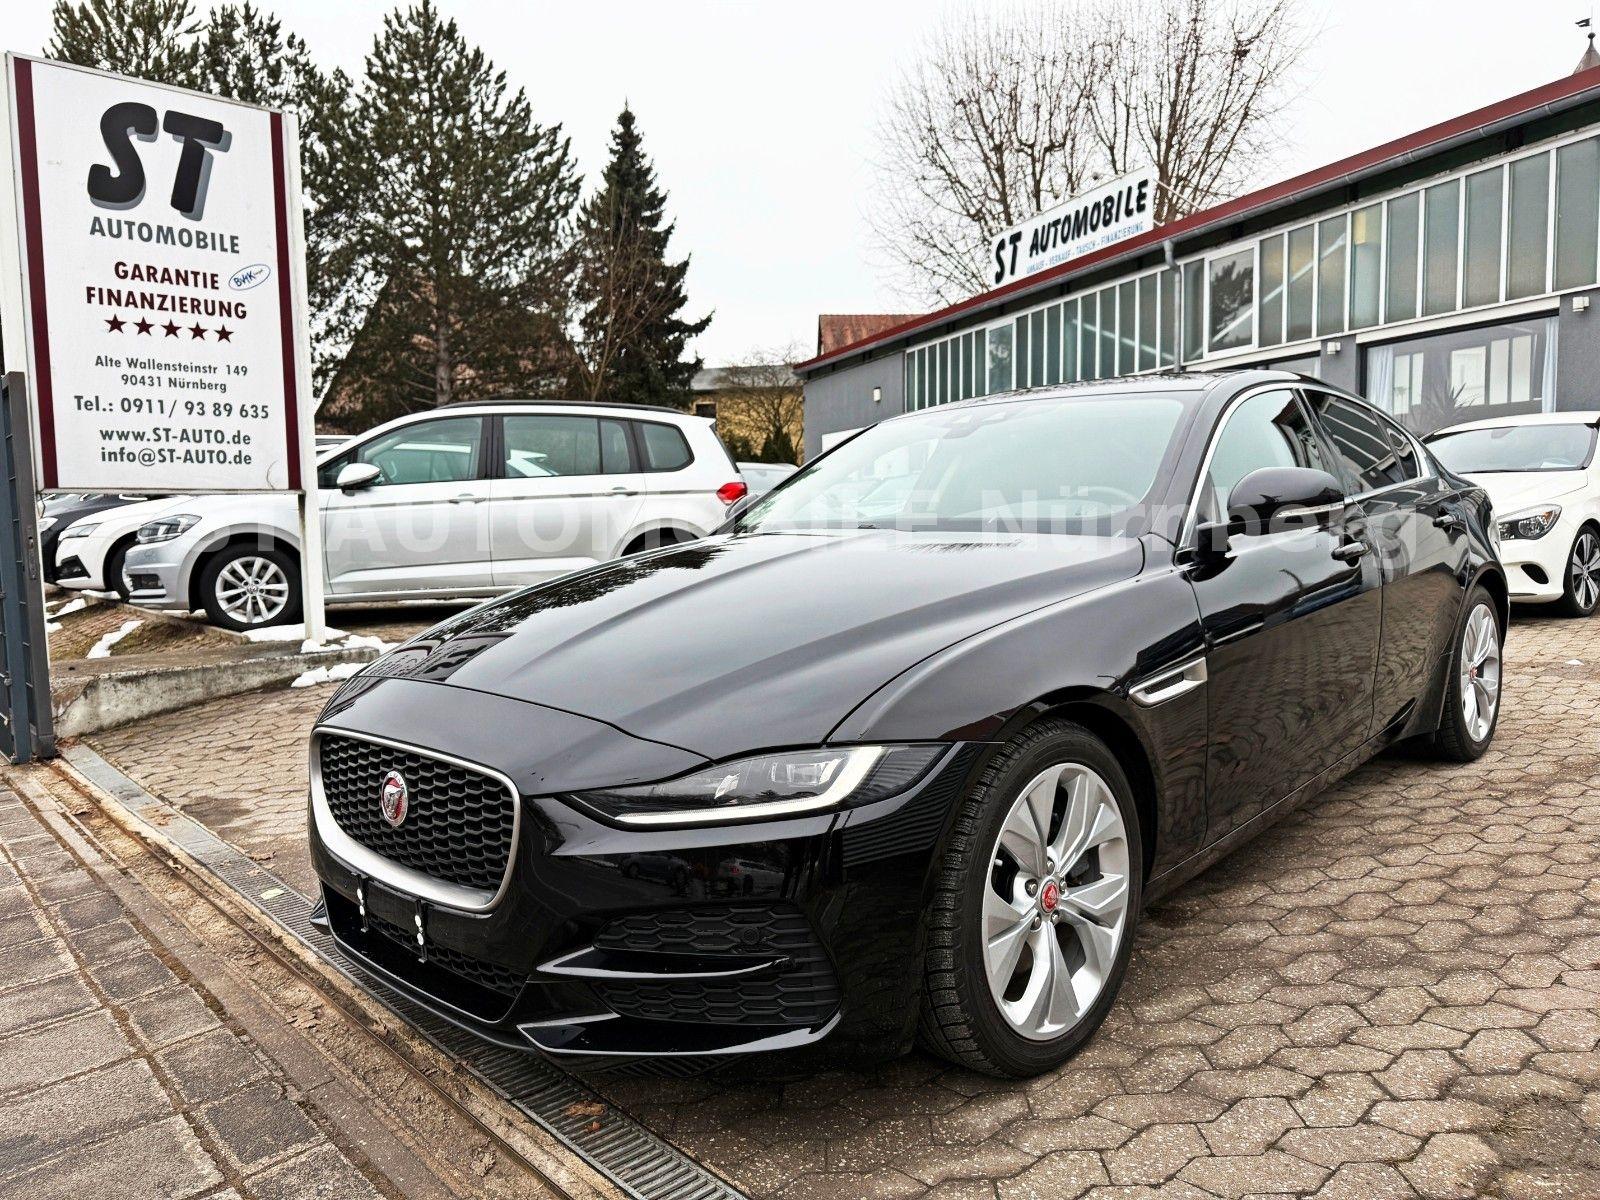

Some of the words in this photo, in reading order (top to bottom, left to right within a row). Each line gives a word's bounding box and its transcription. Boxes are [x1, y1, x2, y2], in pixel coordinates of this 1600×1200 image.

[87, 102, 232, 221] ST
[89, 216, 240, 254] AUTOMOBILE
[995, 231, 1022, 284] ST
[1029, 179, 1148, 258] AUTOMOBILE
[114, 261, 220, 290] GARANTIE
[86, 286, 247, 319] FINANZIERUNG
[95, 355, 121, 368] Alte
[126, 357, 218, 374] Wallensteinstr
[226, 364, 248, 376] 149
[121, 374, 162, 387] 90431
[168, 377, 227, 393] Nürnberg
[74, 396, 113, 412] Tel.:
[185, 401, 206, 416] 93
[213, 402, 233, 417] 89
[240, 404, 269, 419] 635
[100, 428, 251, 445] www.ST-AUTO.de
[101, 447, 252, 466] info@ST-AUTO.de
